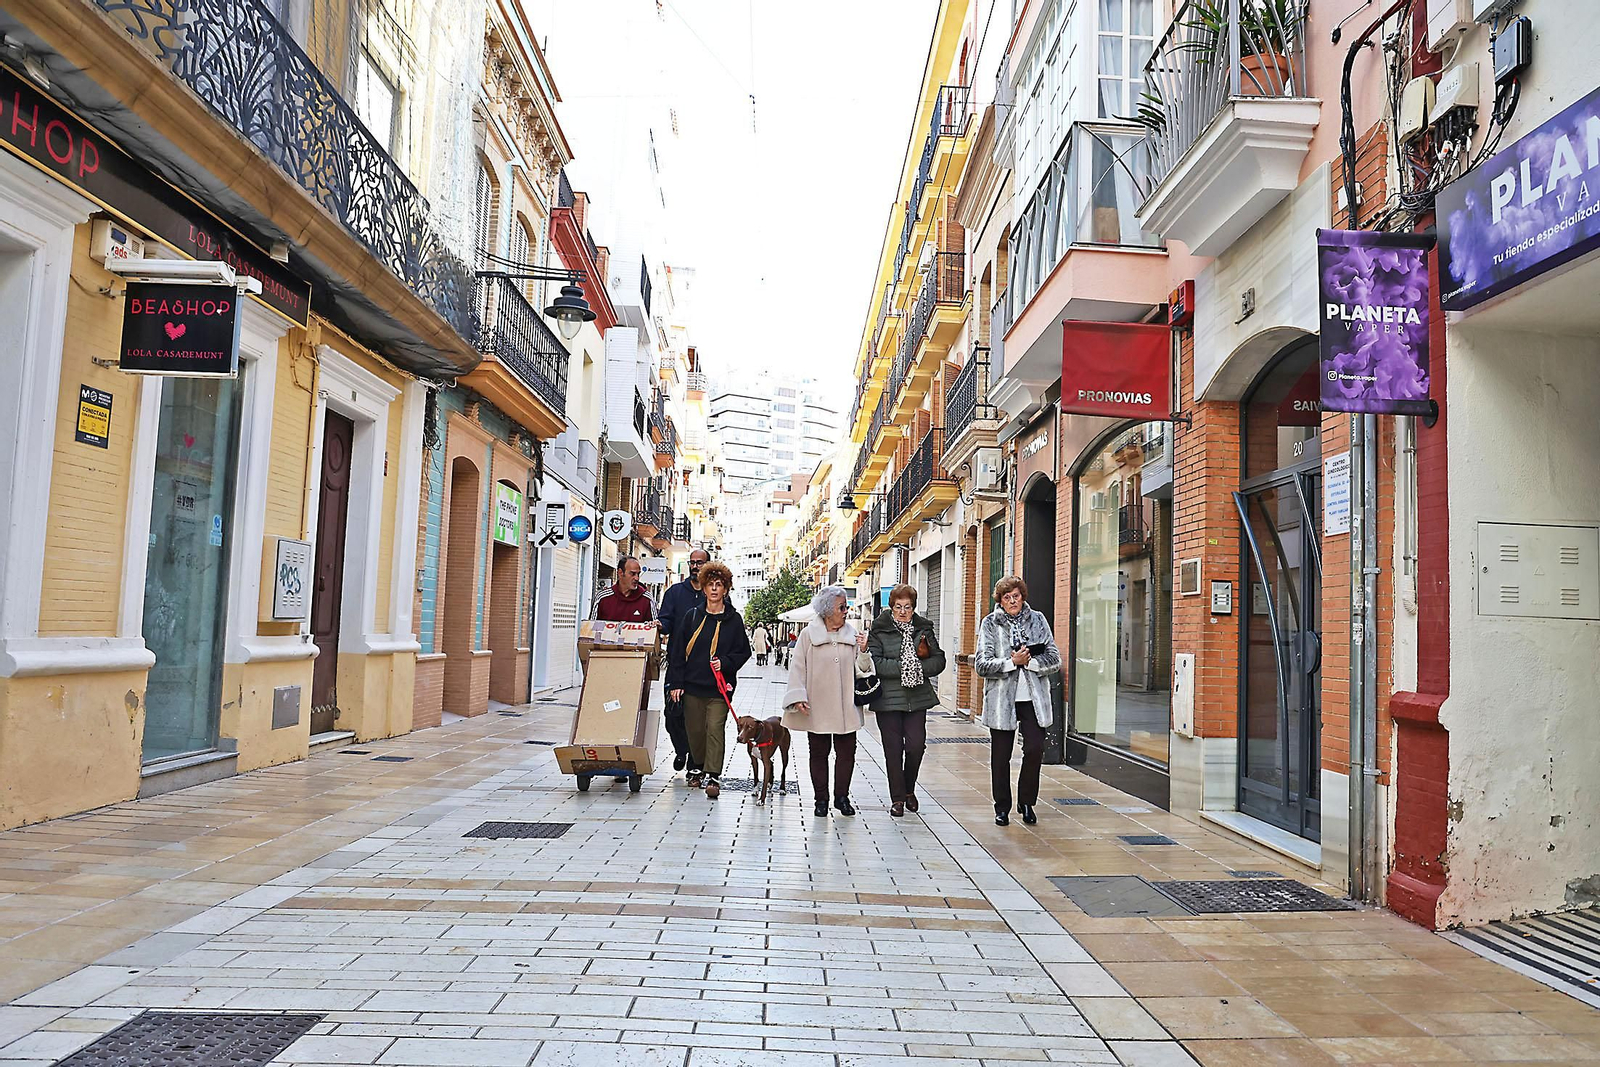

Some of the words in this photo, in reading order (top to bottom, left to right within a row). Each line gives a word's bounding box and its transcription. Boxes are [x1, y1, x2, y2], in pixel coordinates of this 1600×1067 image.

[0, 92, 99, 177] HOP
[1493, 254, 1504, 265] Tu
[1505, 237, 1535, 260] tienda
[188, 224, 222, 260] LOLA
[228, 251, 299, 308] CASADEMUNT
[131, 298, 230, 316] BEASHOP
[1326, 303, 1421, 325] PLANETA
[1344, 322, 1404, 334] VAPER
[127, 349, 152, 357] LOLA
[156, 350, 224, 359] CASADEMUNT
[1078, 390, 1152, 404] PRONOVIAS
[1293, 441, 1303, 457] 20
